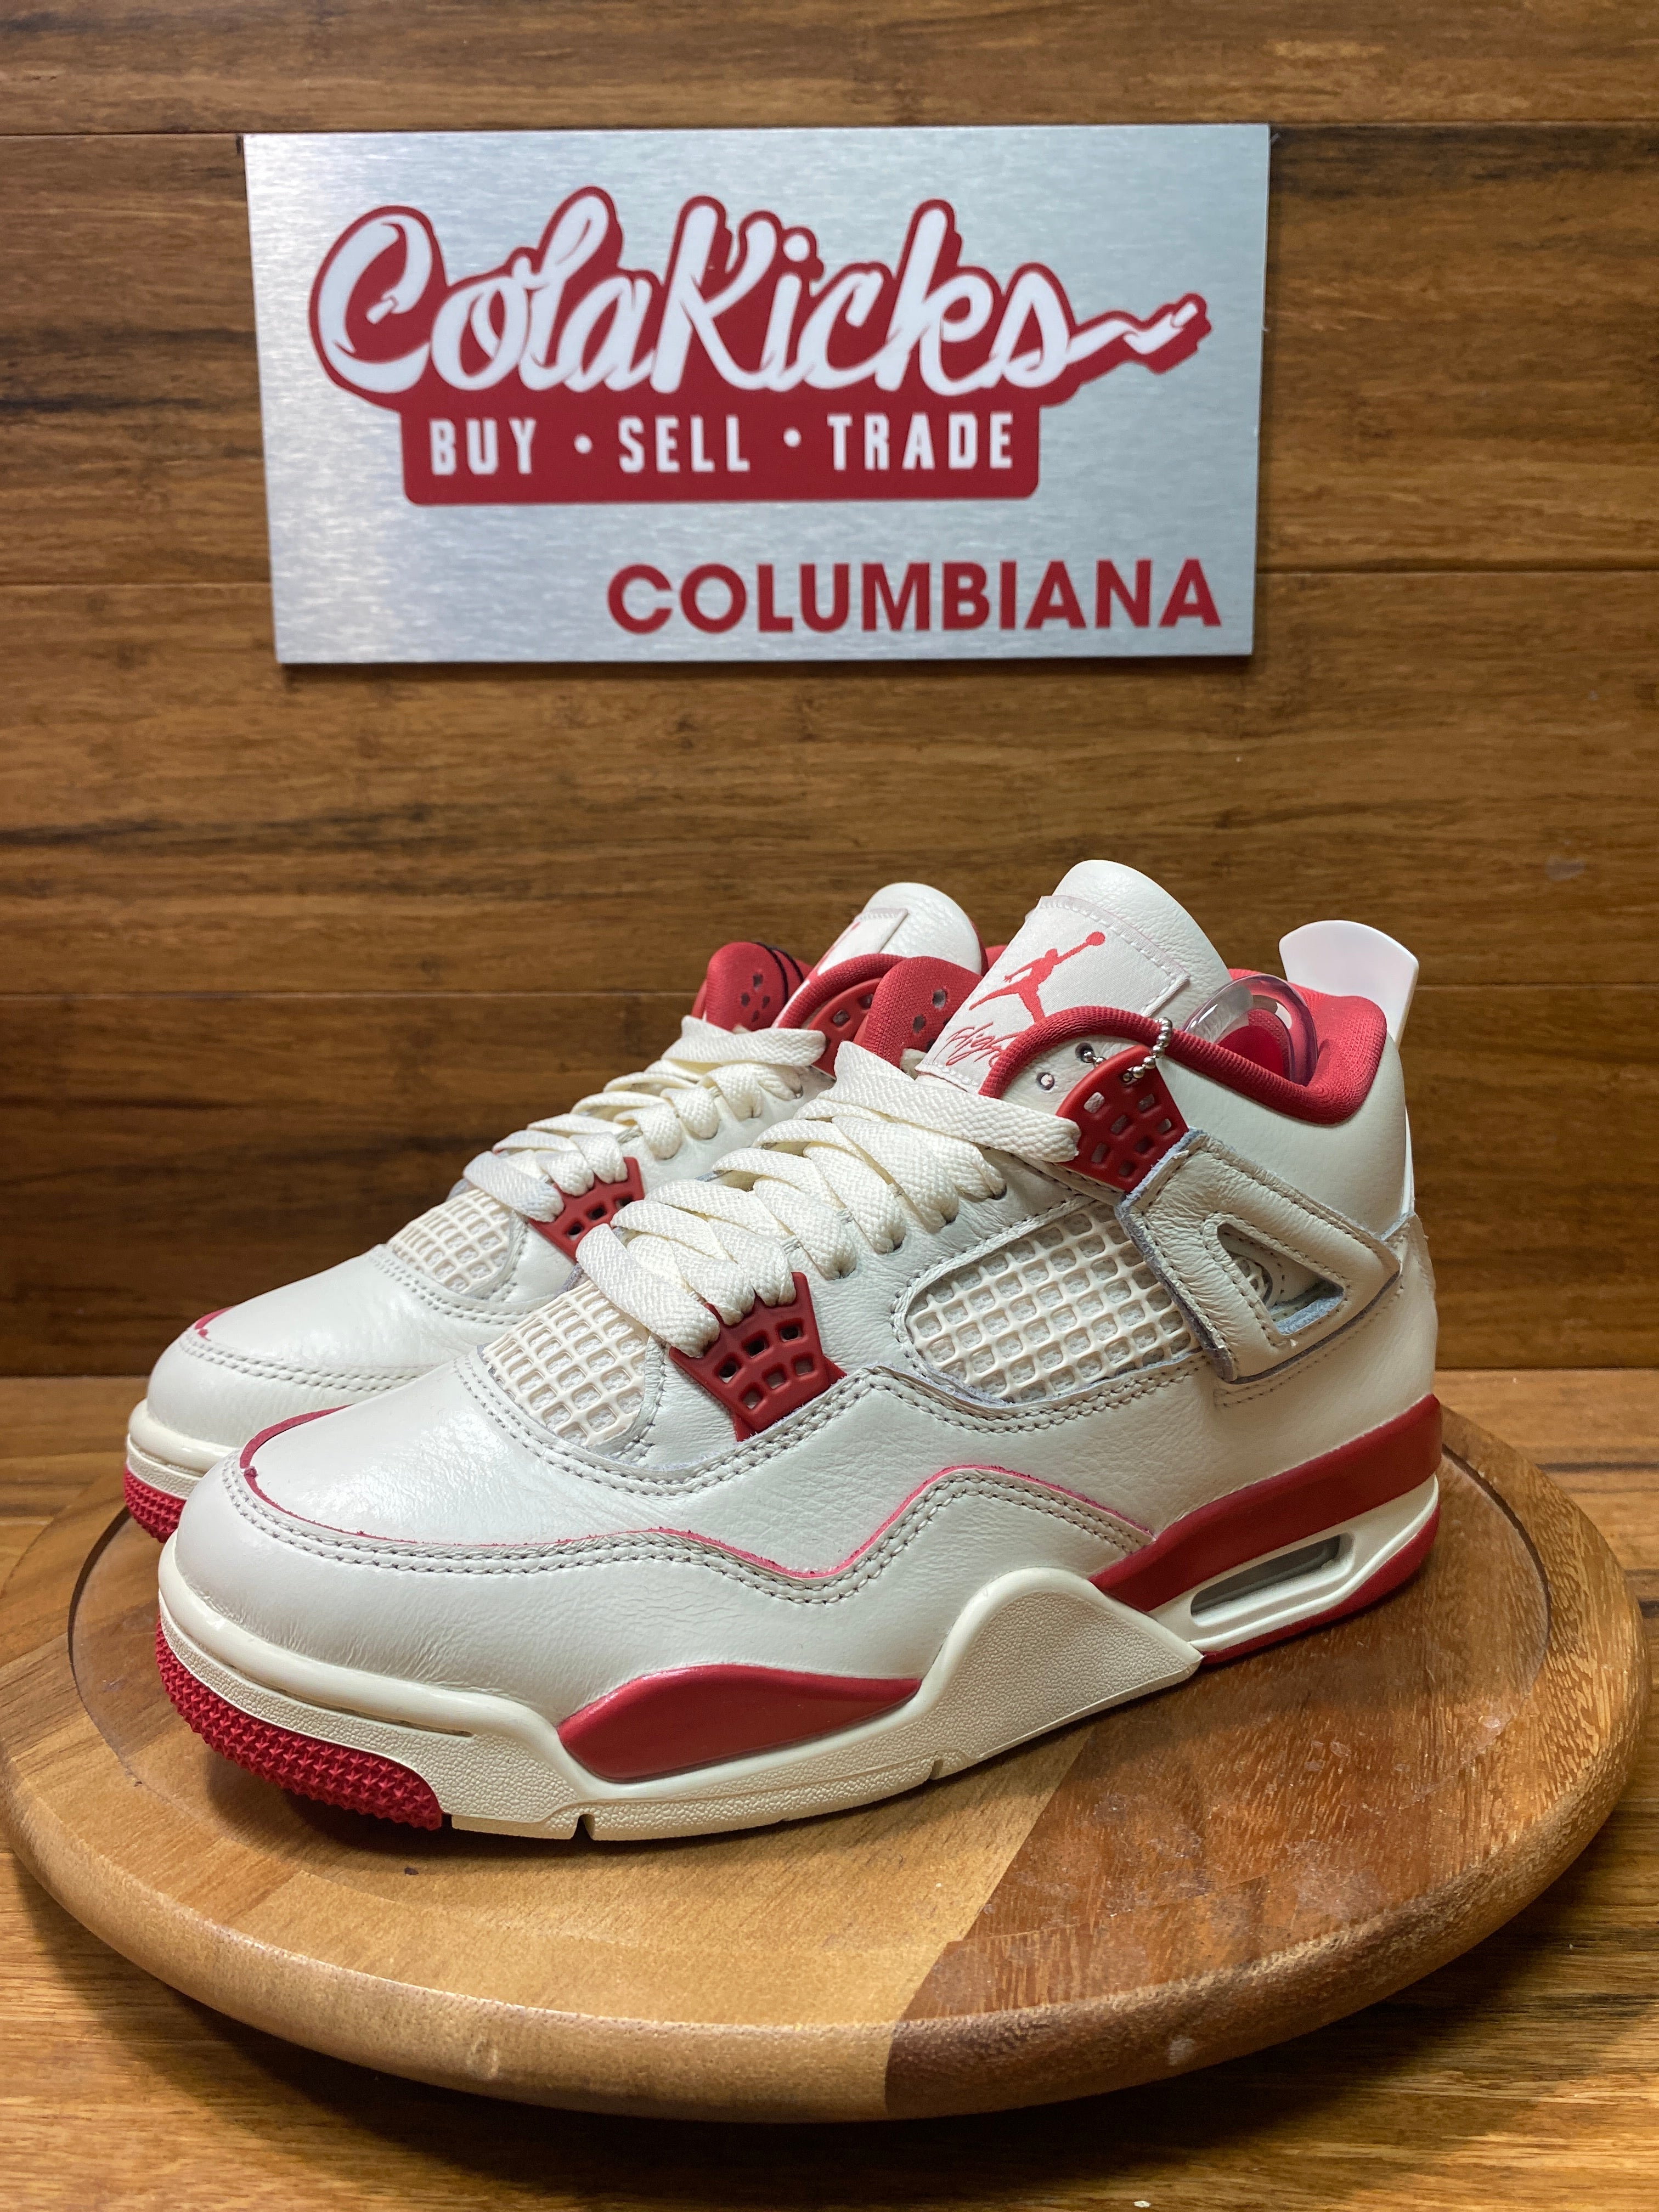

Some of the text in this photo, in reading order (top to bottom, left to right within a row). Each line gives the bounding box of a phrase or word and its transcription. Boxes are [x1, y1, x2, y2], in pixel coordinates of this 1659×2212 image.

[317, 194, 1198, 397] ColaKicks
[429, 411, 1013, 476] BUY SELL TRADE
[608, 558, 1220, 633] COLUMBIANA
